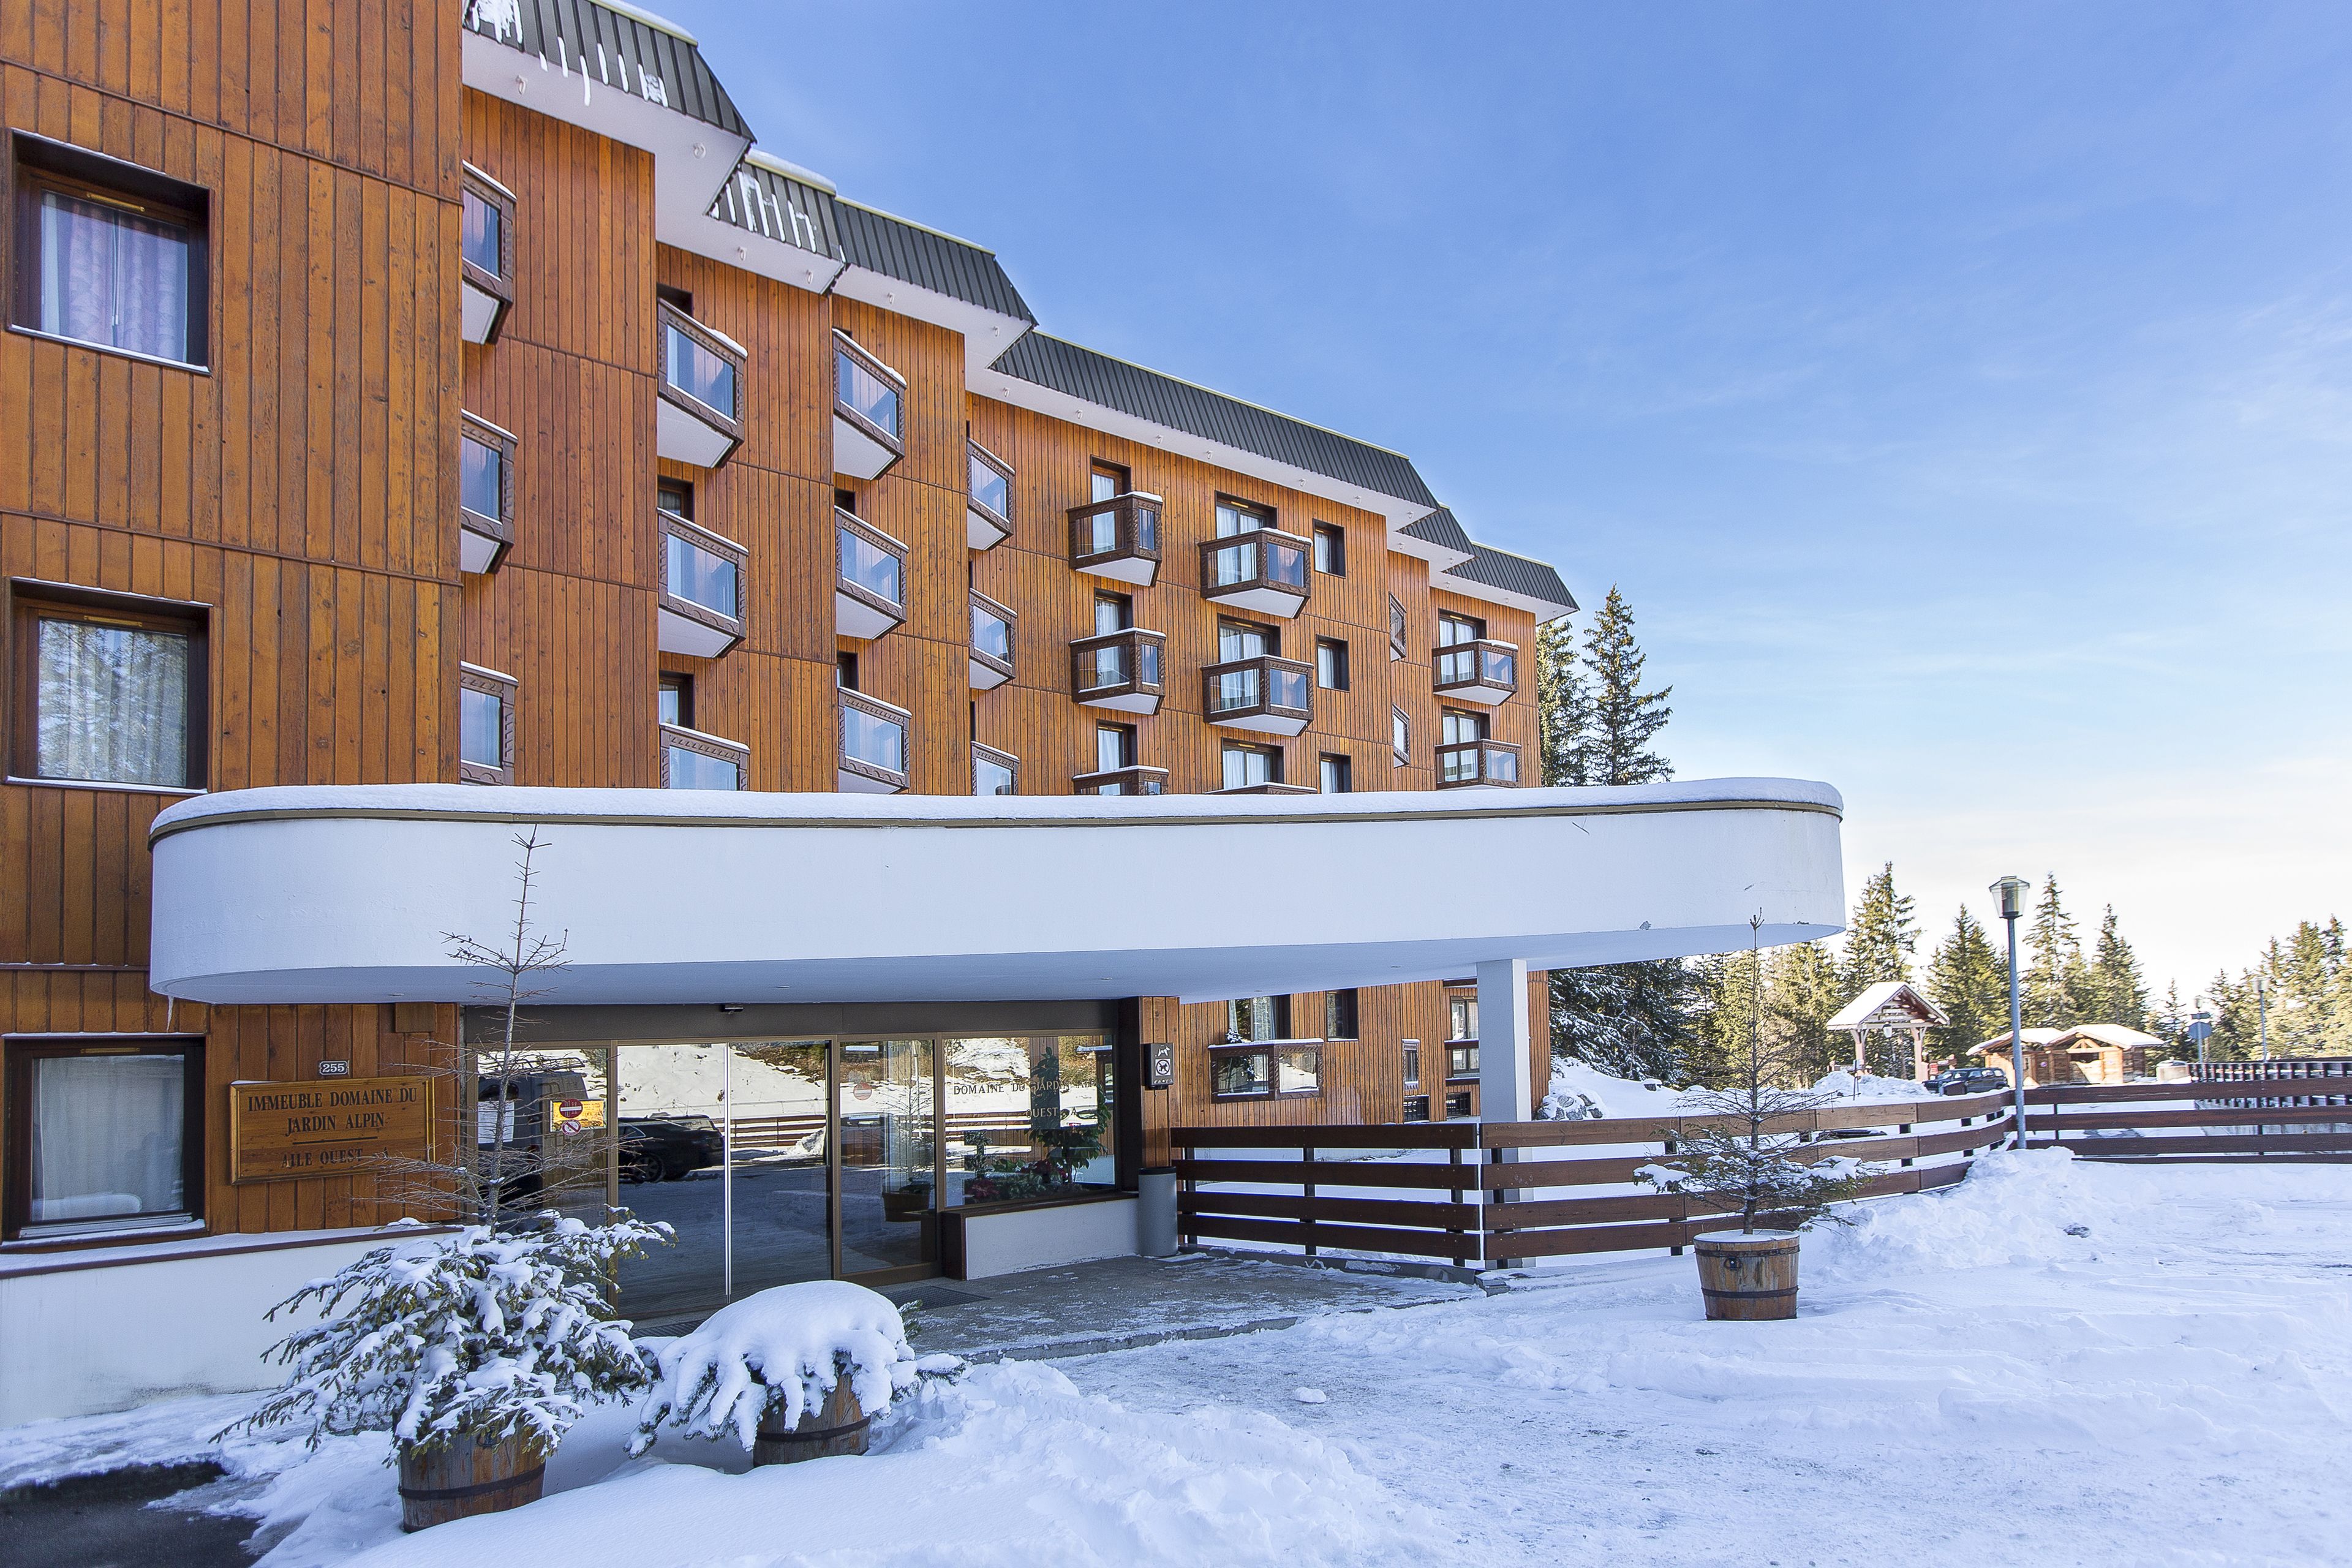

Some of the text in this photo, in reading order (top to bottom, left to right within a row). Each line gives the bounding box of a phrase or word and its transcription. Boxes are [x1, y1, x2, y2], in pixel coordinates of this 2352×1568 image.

[323, 1063, 344, 1072] 255
[954, 1084, 1004, 1095] DOMAINE
[1012, 1083, 1025, 1092] DU
[248, 1087, 417, 1111] IMMEUBLE DOMAINE DU
[1025, 1107, 1058, 1118] OUEST
[285, 1112, 385, 1136] JARDIN ALPIN
[281, 1152, 312, 1167] AILE
[320, 1148, 363, 1164] OUEST
